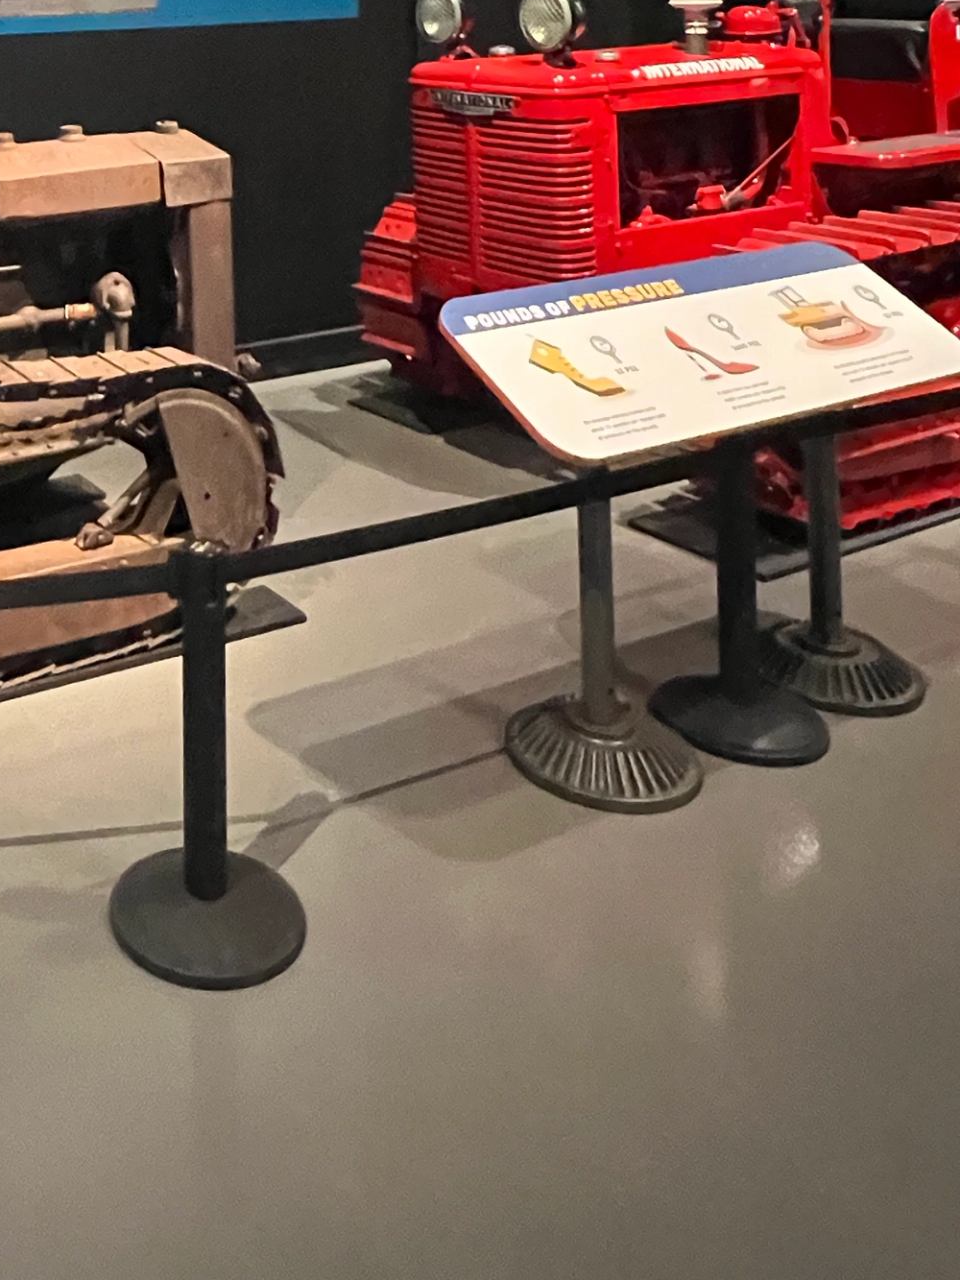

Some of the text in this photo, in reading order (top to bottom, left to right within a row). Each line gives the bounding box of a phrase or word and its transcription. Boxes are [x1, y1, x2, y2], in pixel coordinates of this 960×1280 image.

[640, 56, 766, 80] INTERNATIONAL
[463, 279, 685, 332] POUNDS OF PRESSURE
